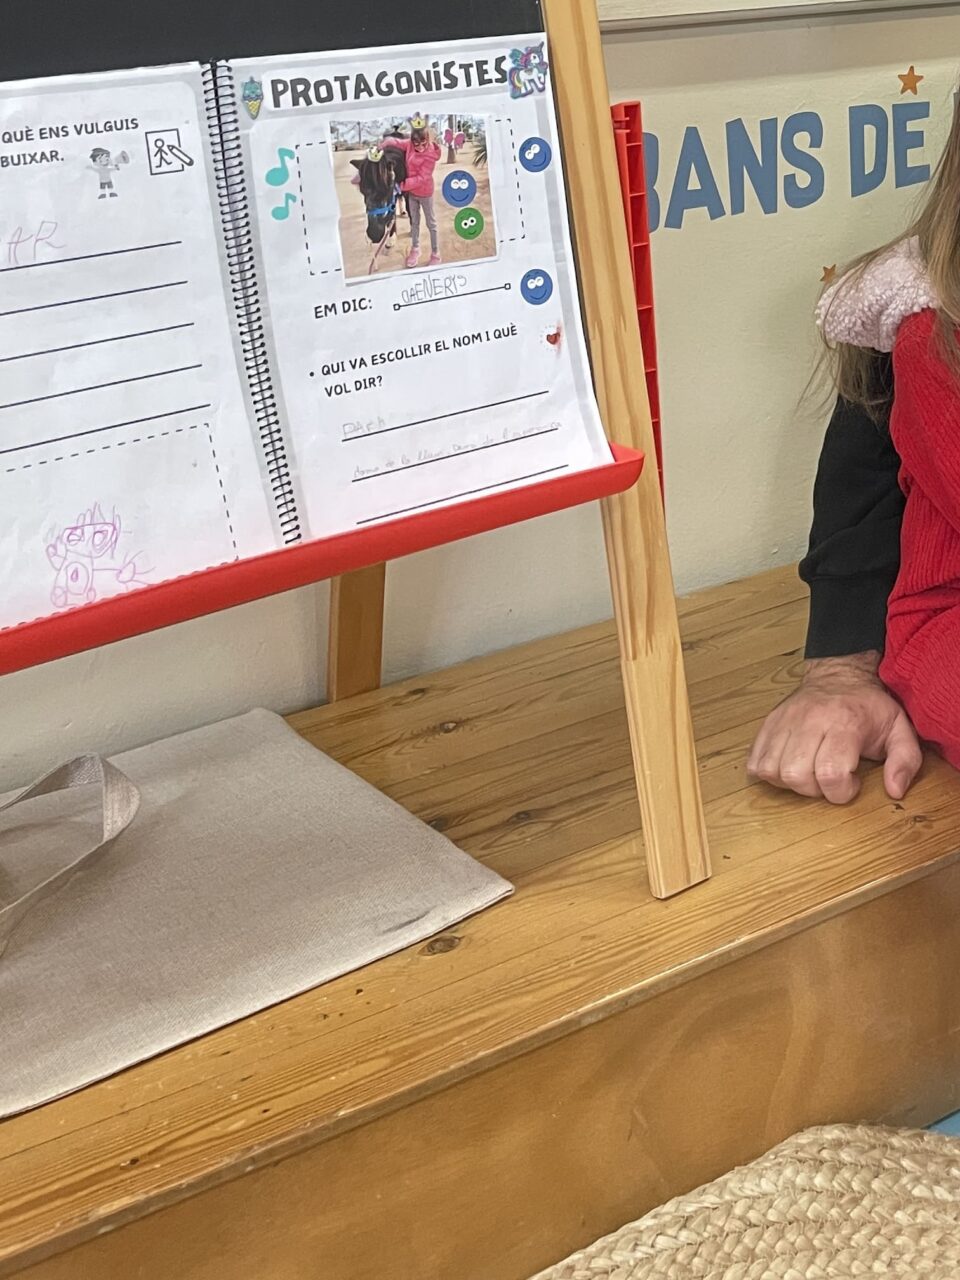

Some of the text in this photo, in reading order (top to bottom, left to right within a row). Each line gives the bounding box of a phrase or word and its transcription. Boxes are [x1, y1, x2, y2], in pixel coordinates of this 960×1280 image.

[2, 118, 139, 144] QUÈ ENS VULGUIS
[848, 100, 931, 198] DE
[314, 297, 372, 319] EM DIC:
[321, 322, 518, 377] QUI VA ESCOLLIR EL NOM I QUÈ
[324, 374, 384, 398] VOL DIR?
